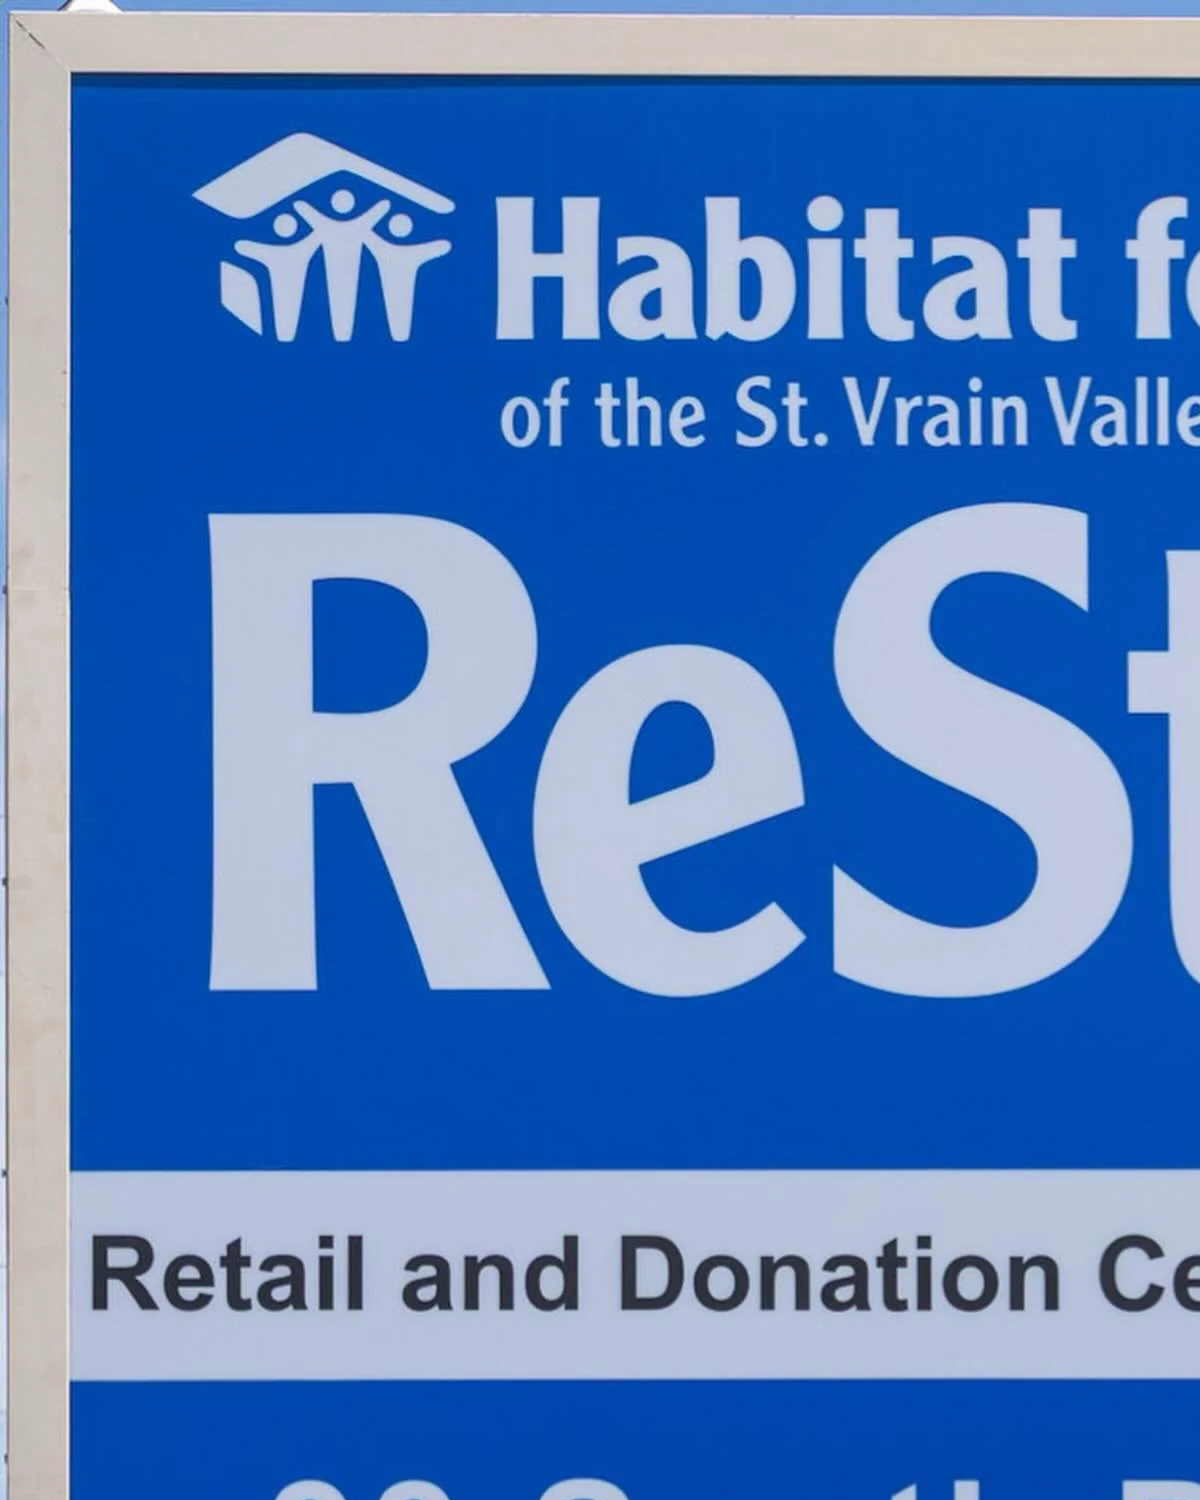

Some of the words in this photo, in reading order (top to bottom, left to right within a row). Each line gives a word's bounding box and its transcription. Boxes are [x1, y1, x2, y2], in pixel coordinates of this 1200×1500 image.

[496, 195, 1077, 342] Habitat
[501, 377, 569, 447] of
[595, 377, 705, 447] the
[736, 375, 828, 447] St.
[843, 377, 1027, 447] Vrain
[91, 1234, 364, 1313] Retail
[401, 1234, 579, 1313] and
[620, 1234, 1060, 1313] Donation
